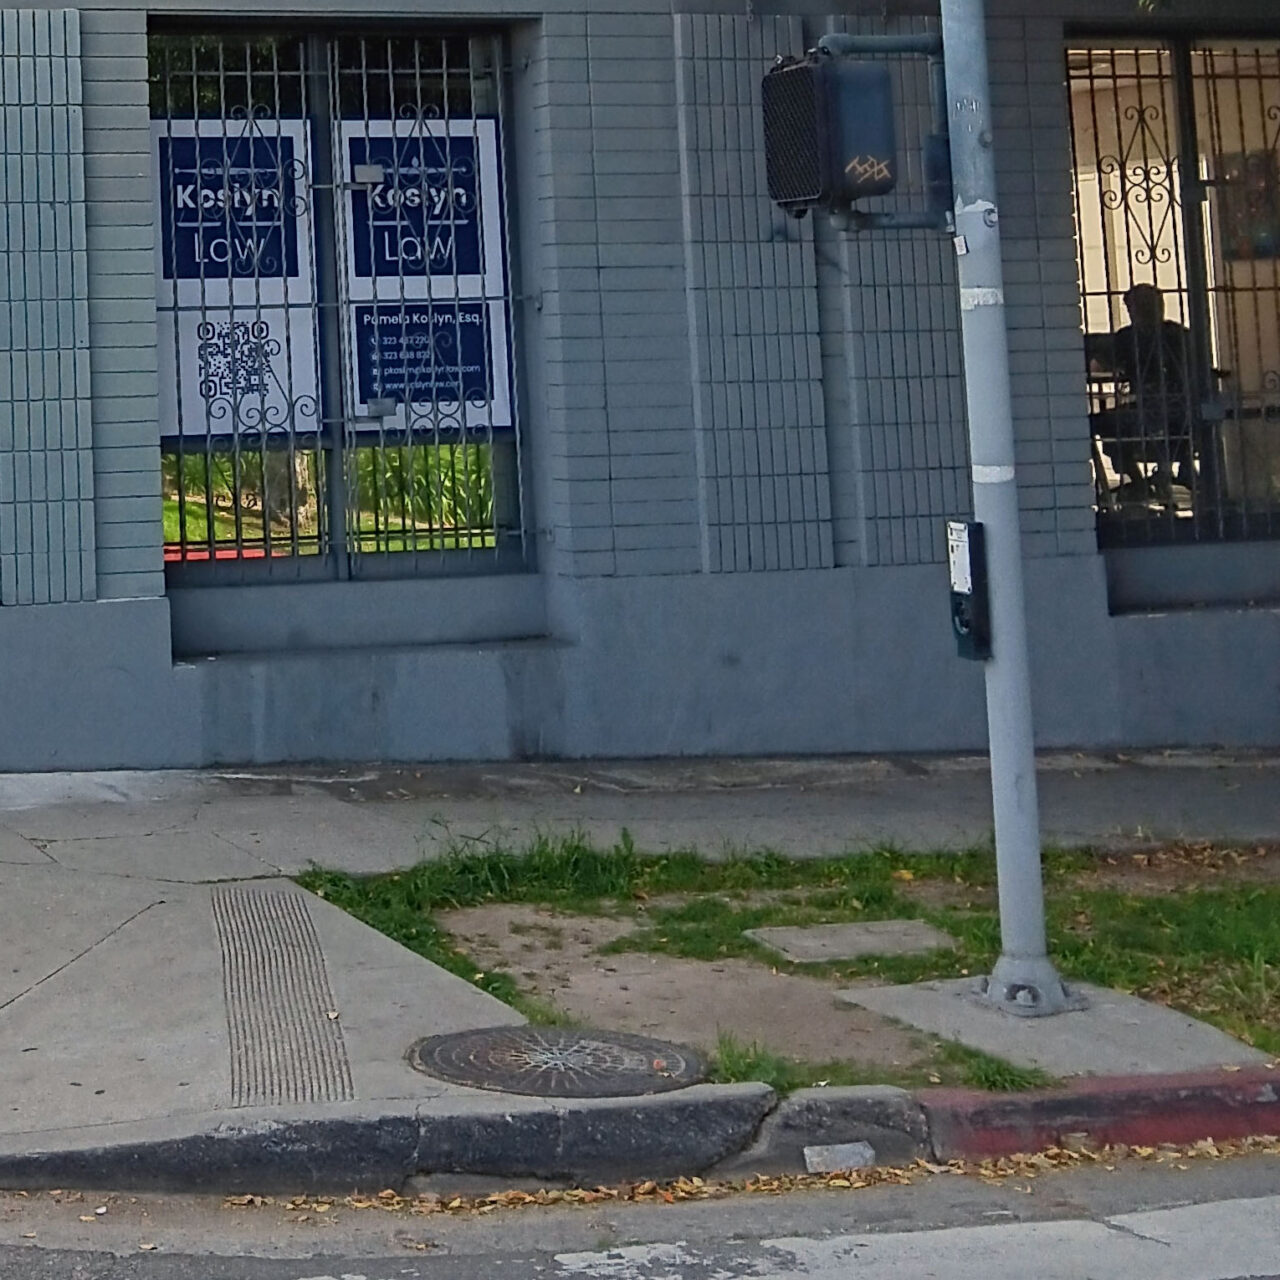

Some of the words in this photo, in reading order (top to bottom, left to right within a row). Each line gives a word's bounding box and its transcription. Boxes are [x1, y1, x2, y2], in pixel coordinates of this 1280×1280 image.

[176, 183, 279, 216] Koslyn
[385, 231, 454, 261] Law
[363, 313, 410, 326] Pamela
[412, 312, 456, 327] Kolyn,
